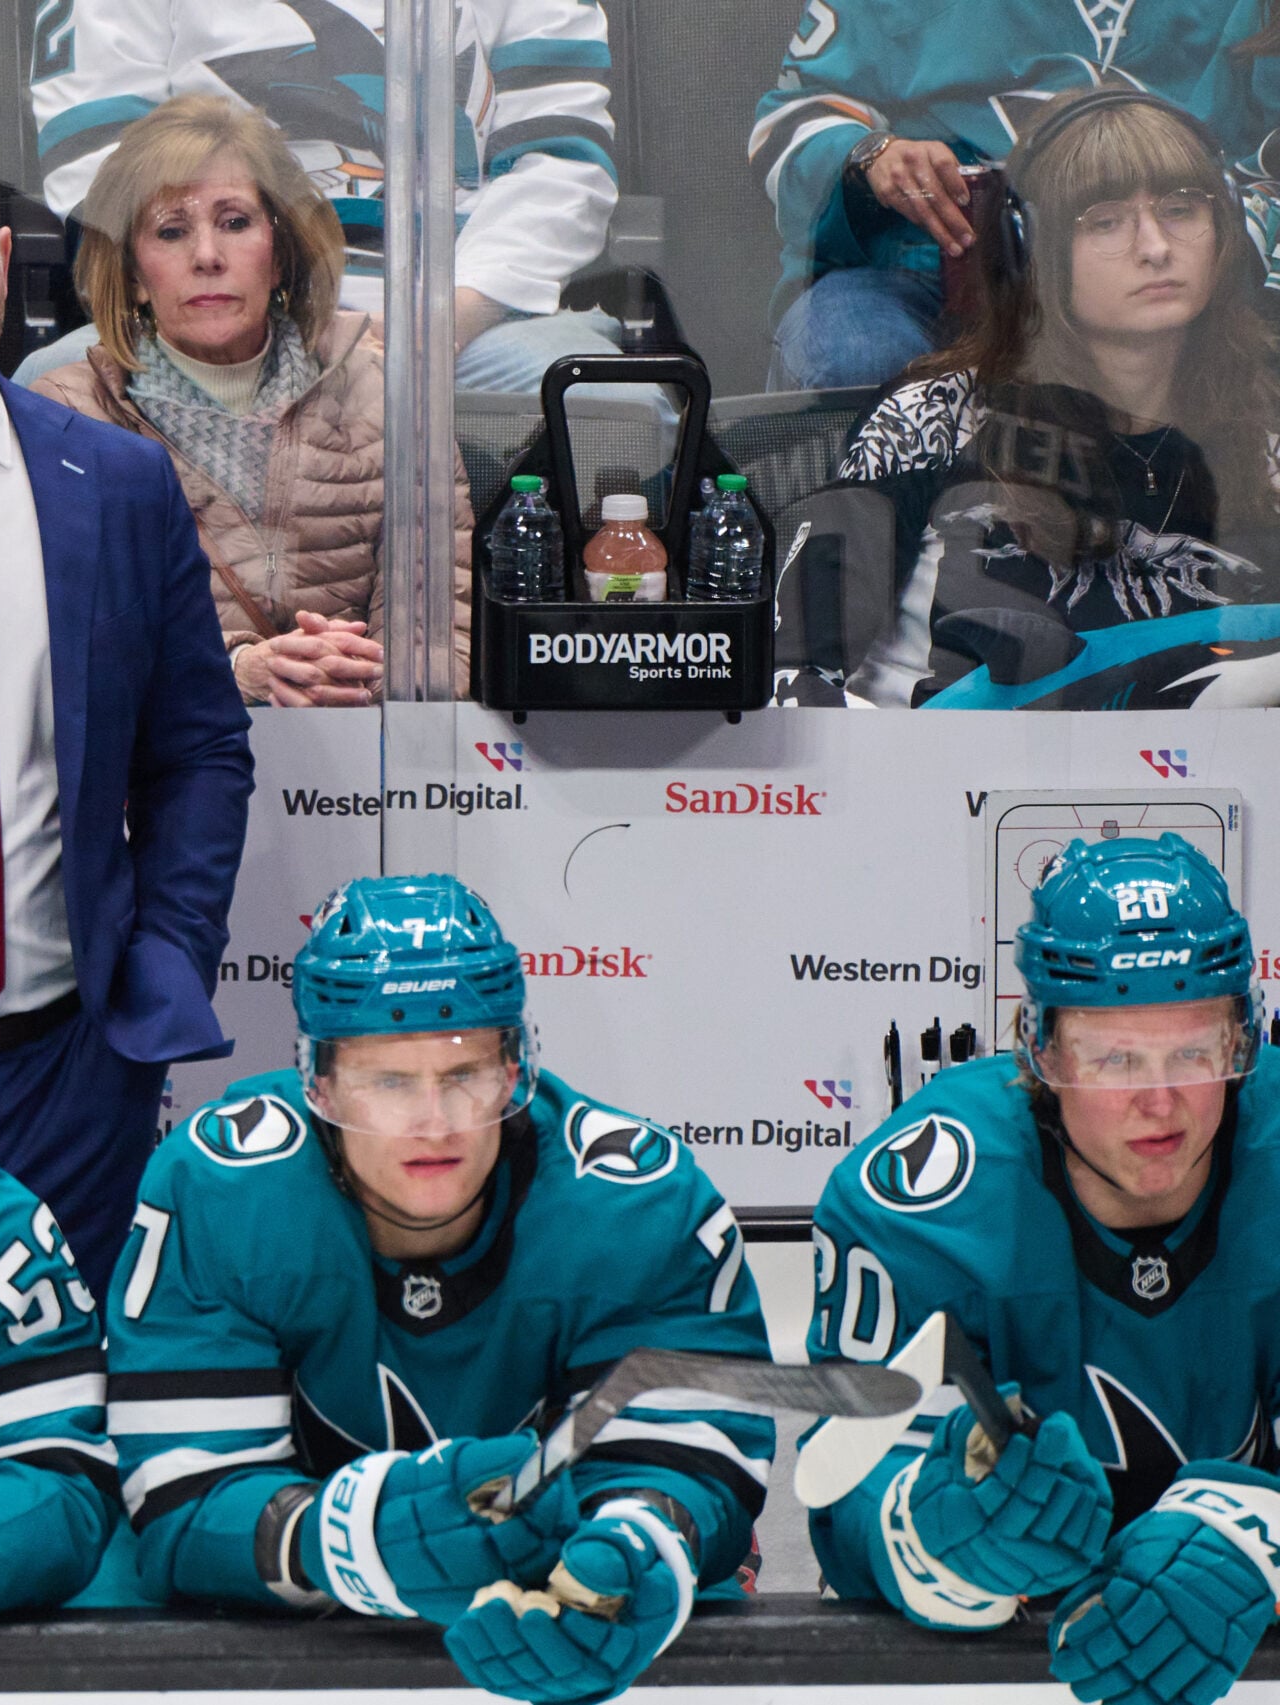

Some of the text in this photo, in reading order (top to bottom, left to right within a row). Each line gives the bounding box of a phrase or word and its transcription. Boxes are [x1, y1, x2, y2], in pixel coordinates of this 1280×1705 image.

[529, 633, 732, 663] BODYARMOR
[629, 665, 732, 681] Sports Drink
[282, 784, 523, 816] Western Digital
[666, 782, 822, 815] SanDisk
[1116, 888, 1169, 921] 20
[403, 917, 427, 950] 7
[520, 946, 648, 977] anDisk
[791, 955, 921, 982] Western
[1111, 949, 1192, 970] CCM
[381, 979, 457, 995] BAUER
[670, 1119, 851, 1152] stern Digital
[123, 1201, 170, 1319] 7
[696, 1202, 744, 1314] 7
